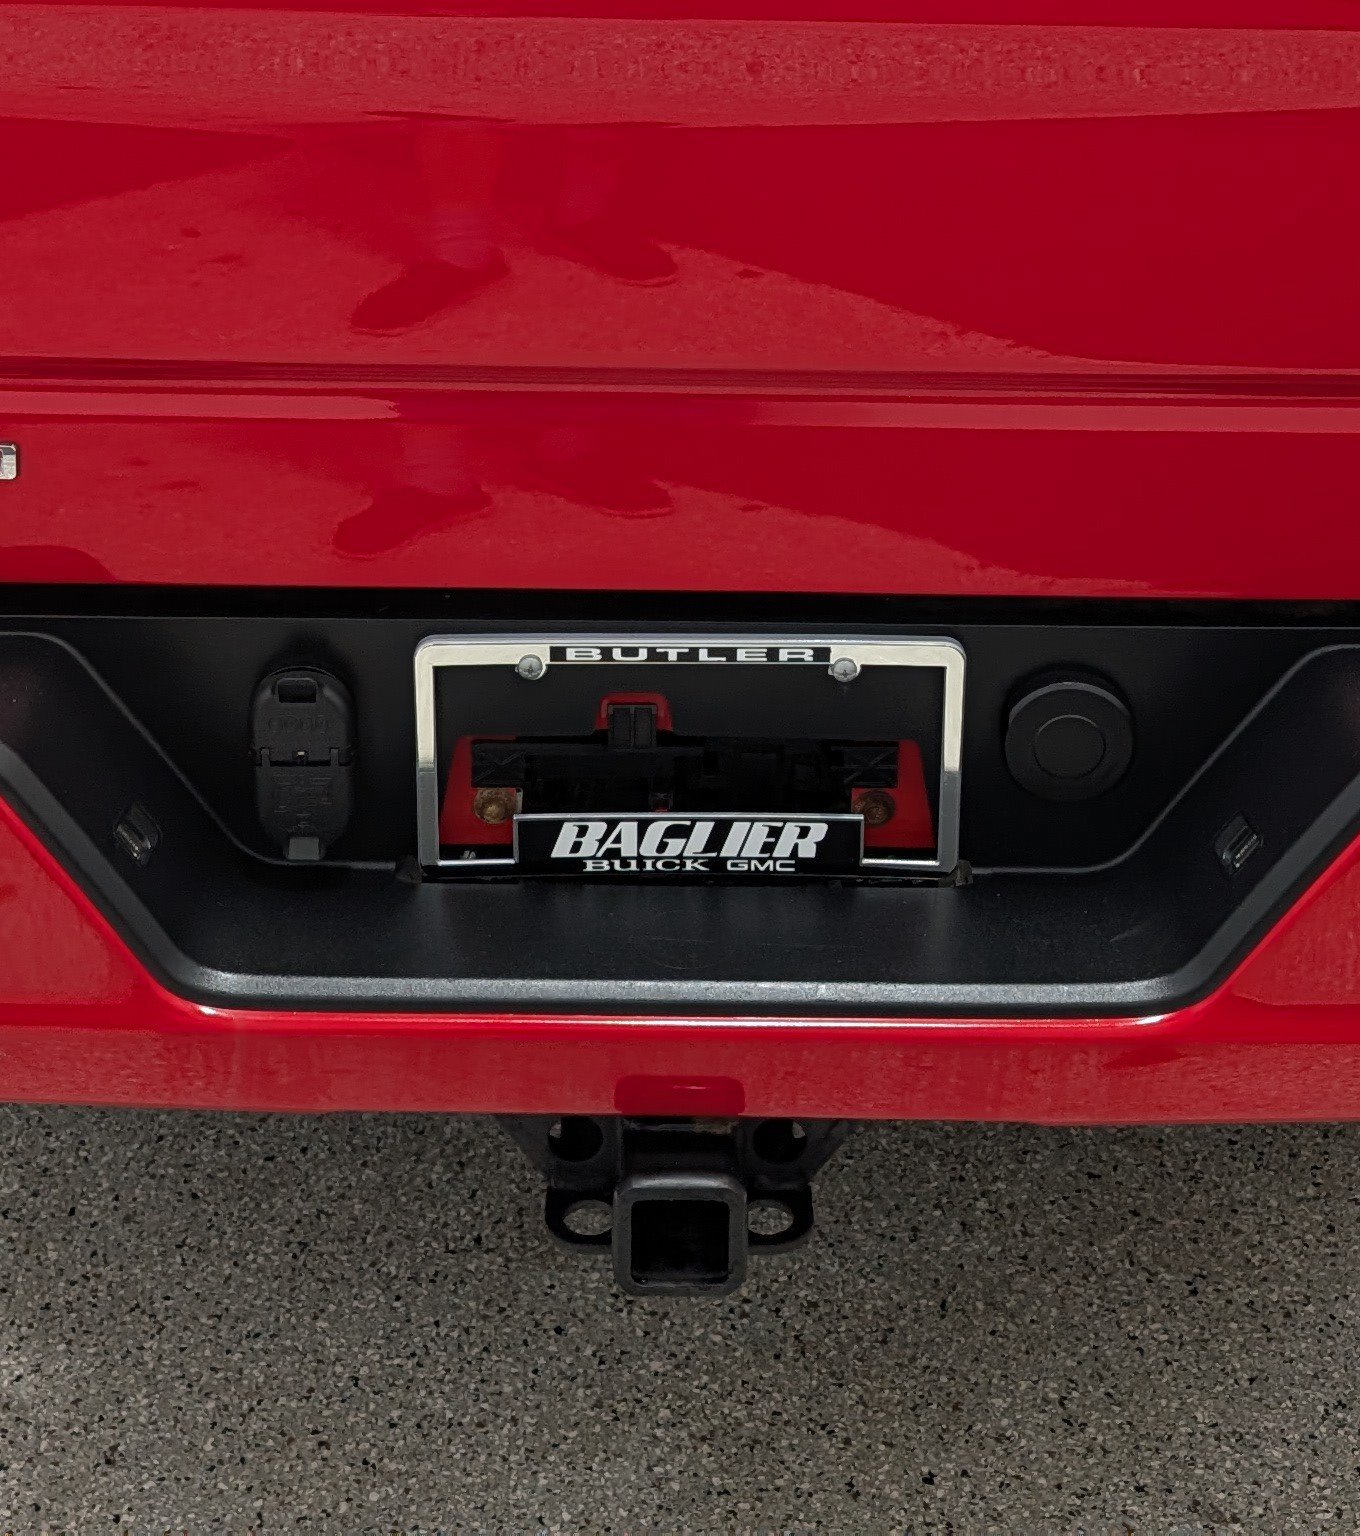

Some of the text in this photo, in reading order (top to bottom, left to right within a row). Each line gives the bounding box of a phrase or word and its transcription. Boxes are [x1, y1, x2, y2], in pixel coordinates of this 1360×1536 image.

[565, 648, 815, 662] BUTLER
[550, 820, 829, 859] BAGLIER
[583, 859, 796, 872] BUICK GMC
